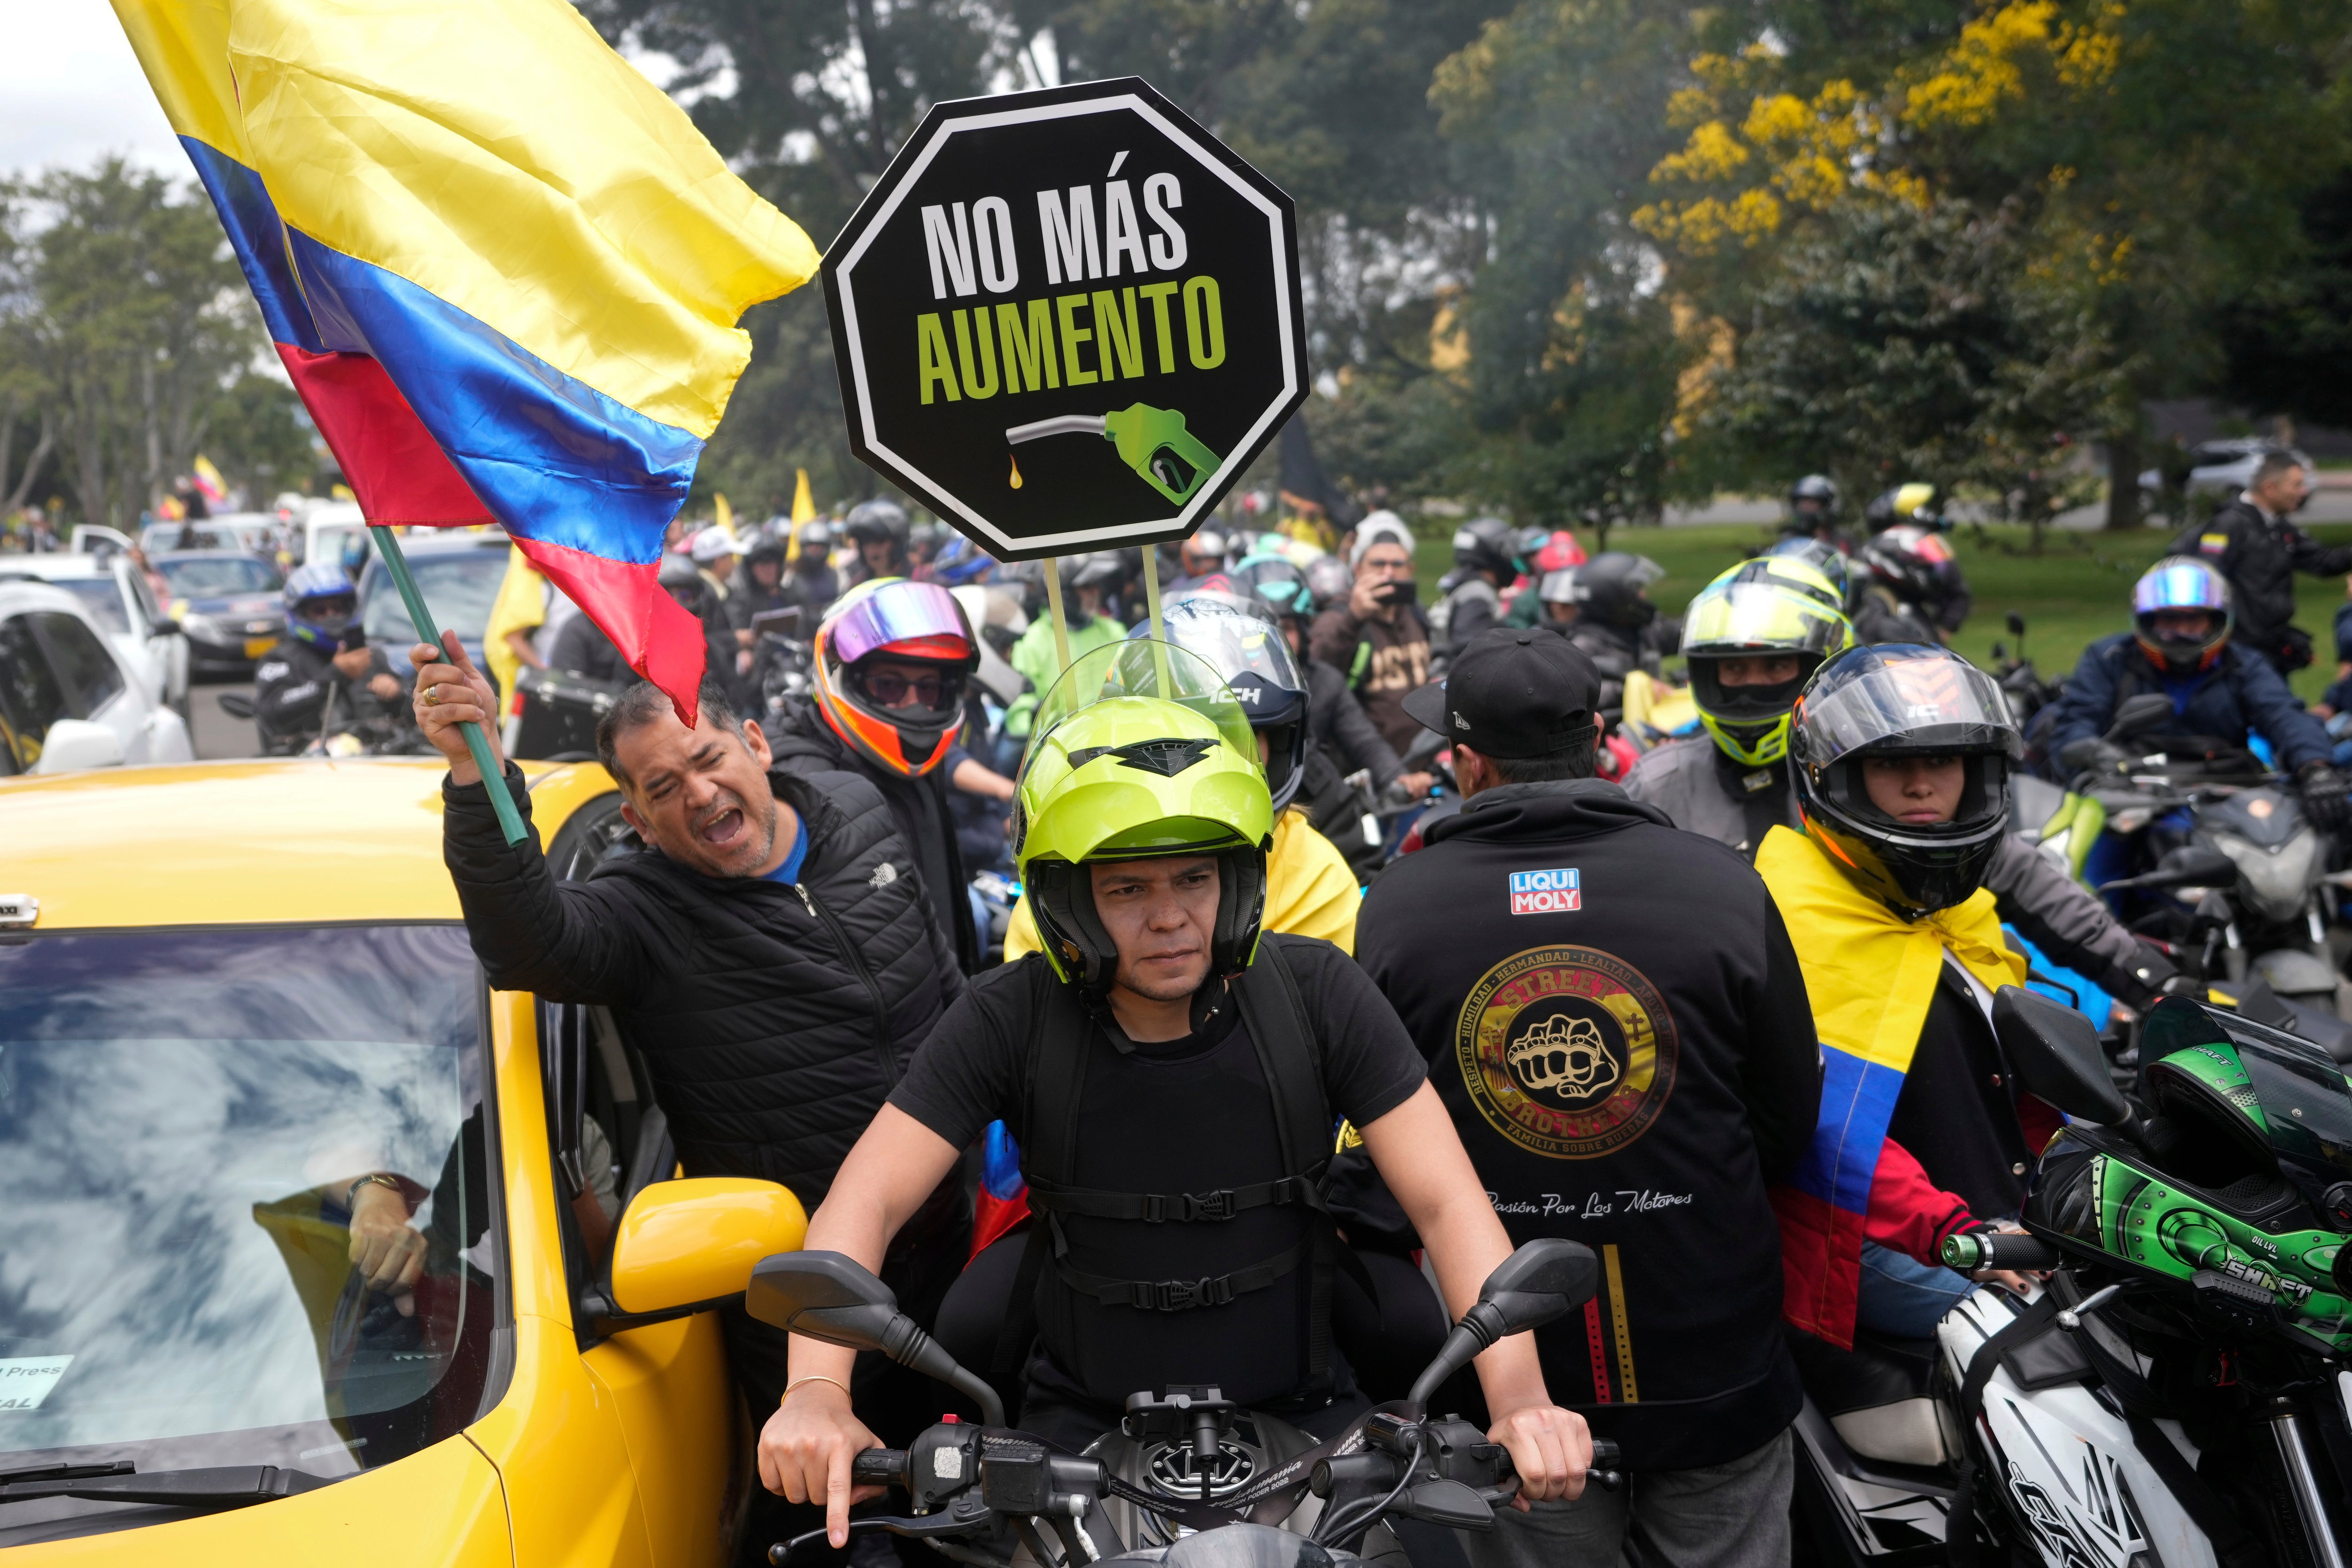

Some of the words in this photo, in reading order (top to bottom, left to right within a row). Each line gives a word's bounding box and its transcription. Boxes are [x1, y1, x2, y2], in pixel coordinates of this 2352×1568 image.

[921, 196, 1019, 300] NO
[1037, 150, 1187, 285] MÁS
[917, 276, 1226, 405] AUMENTO
[1514, 871, 1575, 892] LIQUI
[1515, 890, 1578, 912] MOLY
[1495, 951, 1570, 982] HERMANDAD
[1580, 953, 1632, 982] LEALTAD
[1501, 969, 1618, 1010] STREET
[1461, 983, 1493, 1038] HUMILDAD
[1461, 1046, 1483, 1095] RESPETO
[1500, 1085, 1643, 1138] BROTHERS
[1506, 1123, 1557, 1151] FAMILIA
[1562, 1141, 1603, 1152] SOBRE
[1606, 1112, 1649, 1146] RUEDAS
[1541, 1193, 1575, 1217] Por
[1581, 1192, 1612, 1219] Los
[1615, 1189, 1693, 1213] Motores
[2251, 1236, 2263, 1246] OIL
[2263, 1241, 2278, 1253] LVL
[6, 1367, 62, 1377] Press
[1247, 1486, 1269, 1501] PODER
[1271, 1476, 1289, 1491] 2022
